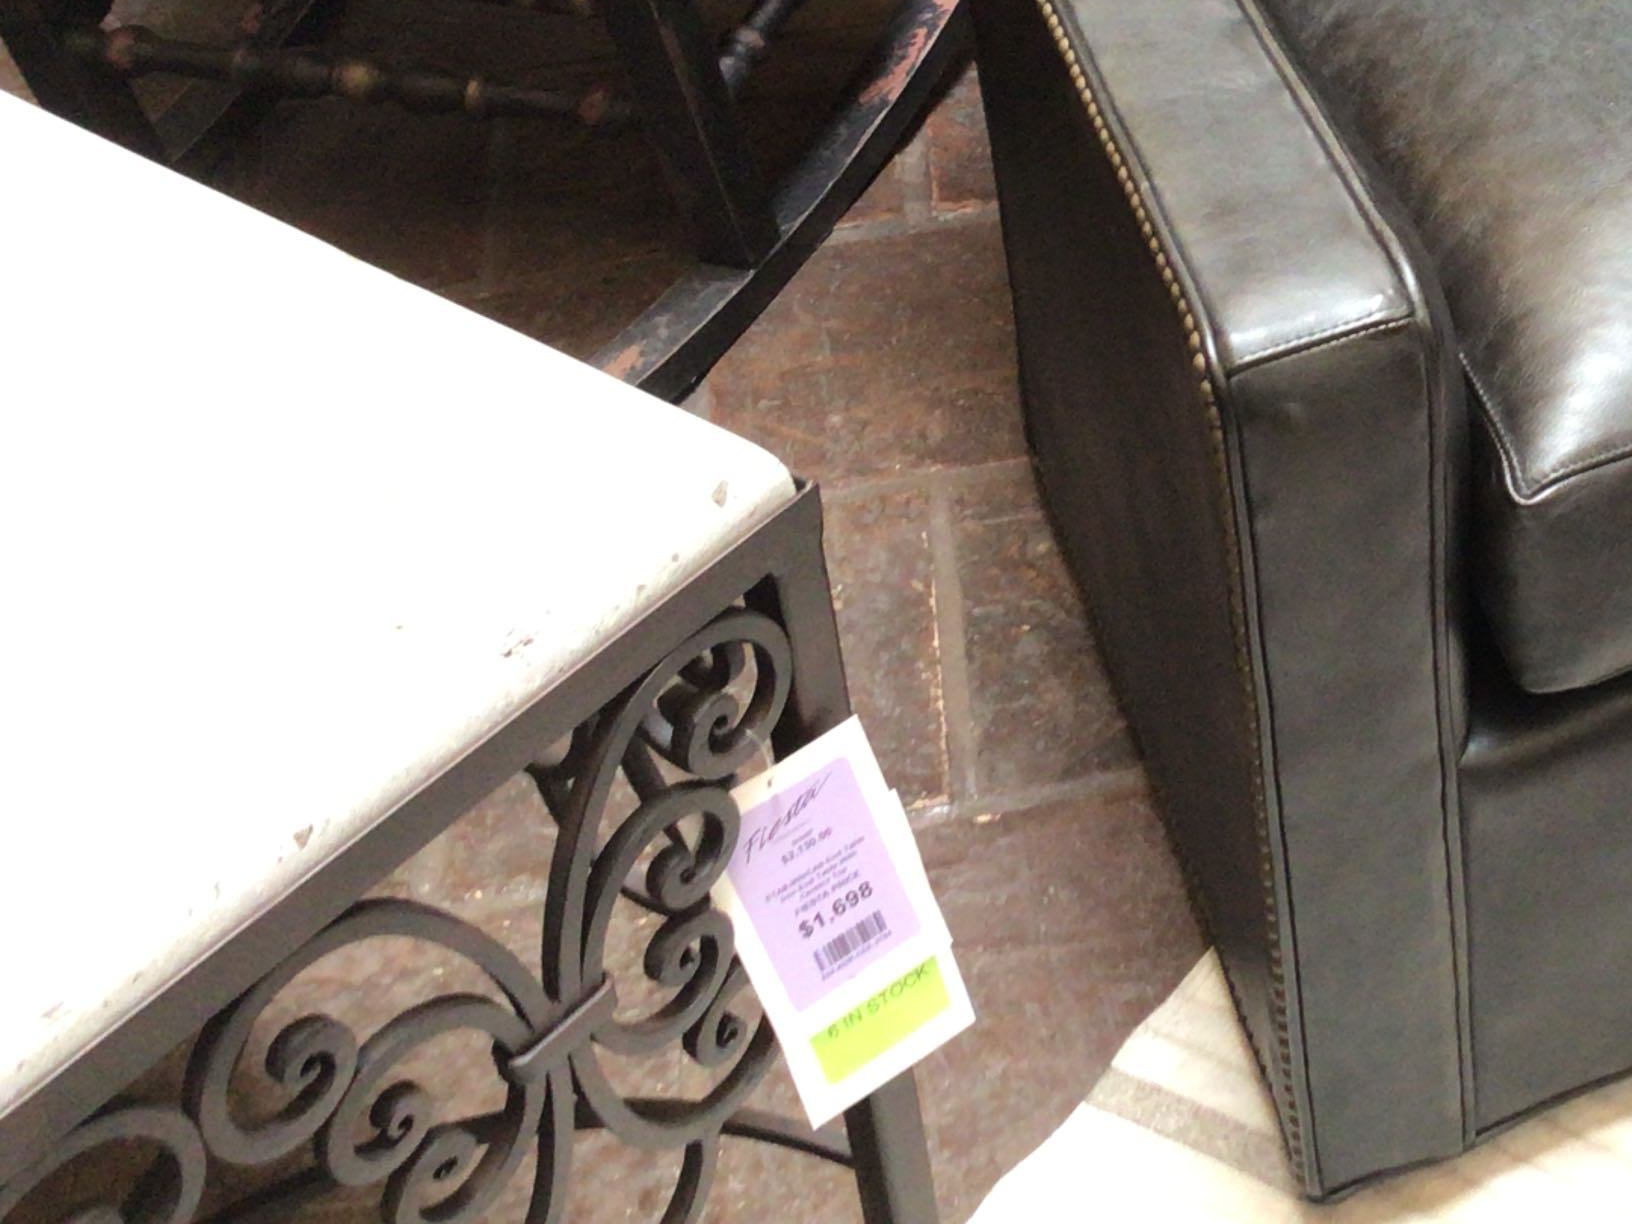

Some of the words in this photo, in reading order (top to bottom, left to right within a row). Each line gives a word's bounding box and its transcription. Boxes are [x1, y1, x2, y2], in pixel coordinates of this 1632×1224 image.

[742, 771, 832, 865] Fiesta
[798, 881, 873, 938] $1,698
[843, 1008, 863, 1028] IN
[866, 963, 929, 1014] STOCK
